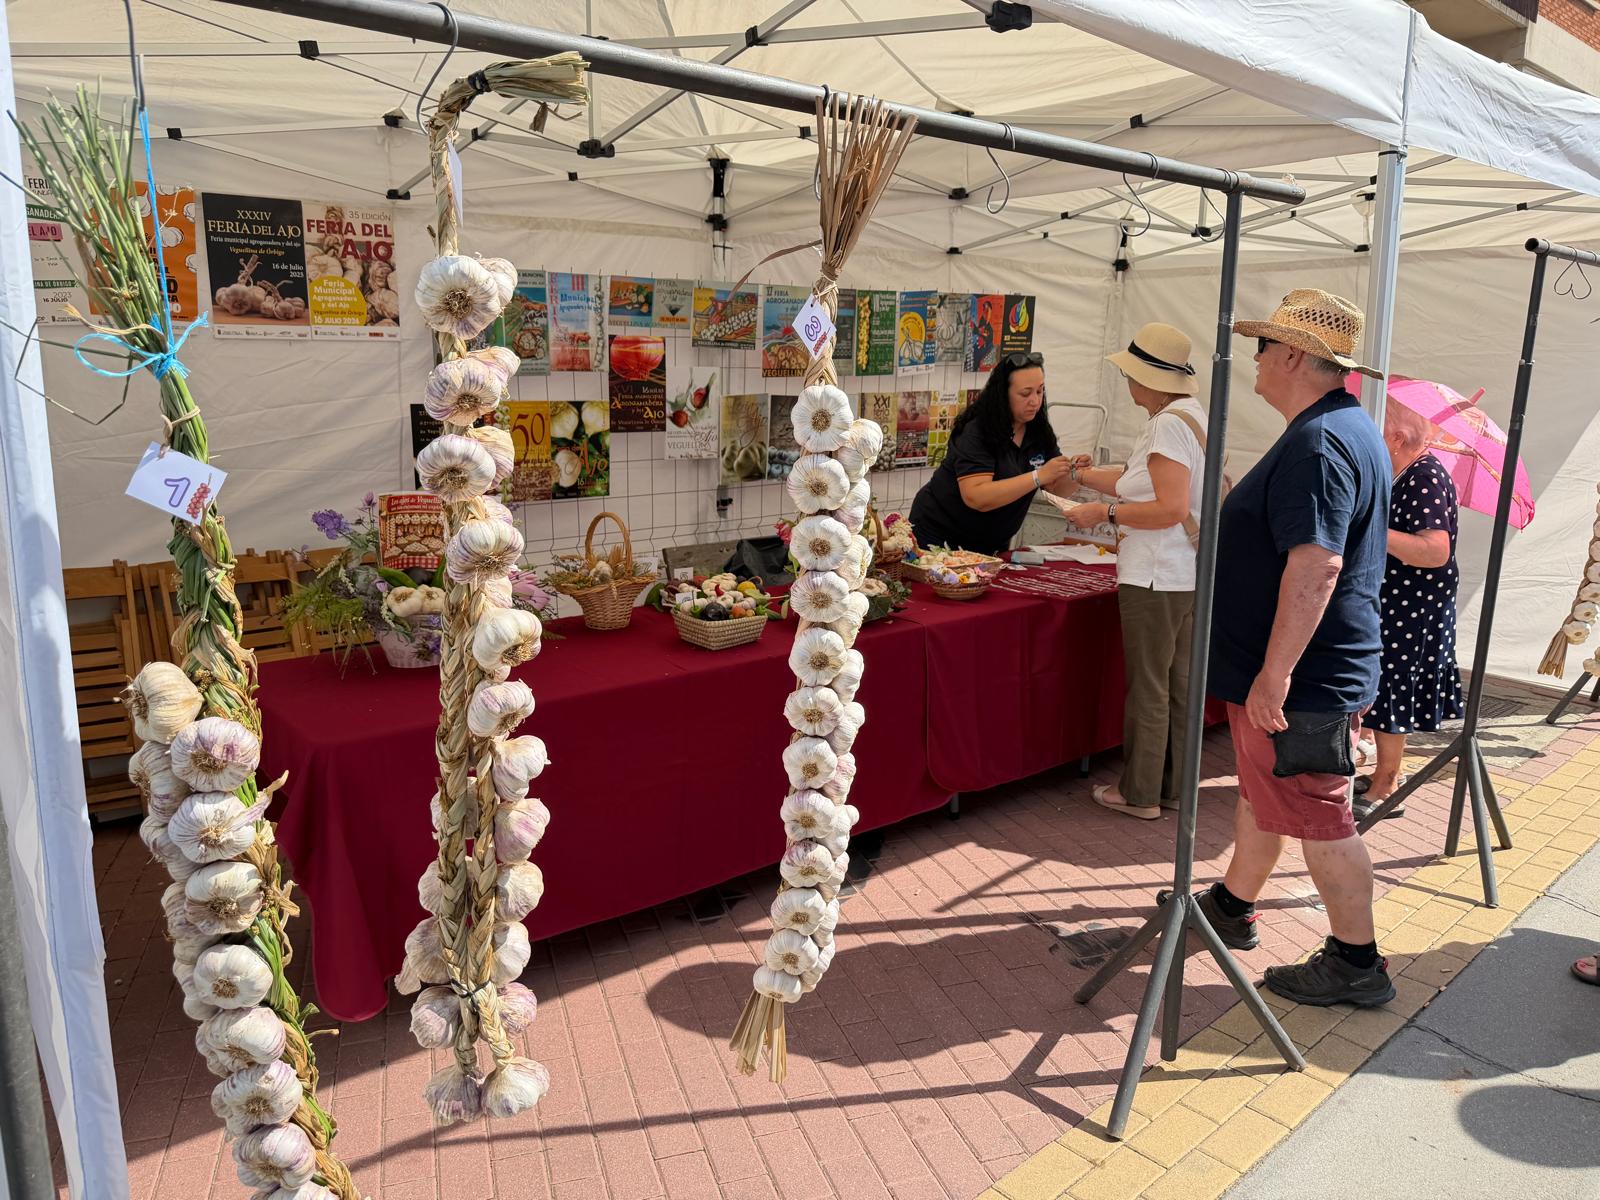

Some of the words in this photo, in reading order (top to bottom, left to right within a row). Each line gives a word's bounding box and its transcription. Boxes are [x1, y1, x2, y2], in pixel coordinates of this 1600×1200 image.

[28, 177, 52, 190] FERI
[237, 209, 272, 221] XXXIV
[348, 210, 360, 220] 35
[361, 211, 391, 222] EDICIÓN
[208, 220, 250, 235] FERIA
[252, 225, 275, 236] DEL
[277, 225, 302, 239] AJO
[306, 219, 357, 237] FERIA
[361, 222, 393, 239] DEL
[341, 238, 394, 263] AJO
[281, 263, 289, 271] de
[289, 263, 304, 272] Julio
[323, 279, 345, 289] Feria
[571, 273, 585, 291] III
[314, 286, 355, 298] Municipal
[314, 315, 324, 325] 16
[325, 317, 342, 325] JULIO
[804, 315, 822, 342] 3
[762, 368, 806, 378] VEGUELLIN
[873, 395, 891, 409] XXI
[512, 412, 545, 465] 50
